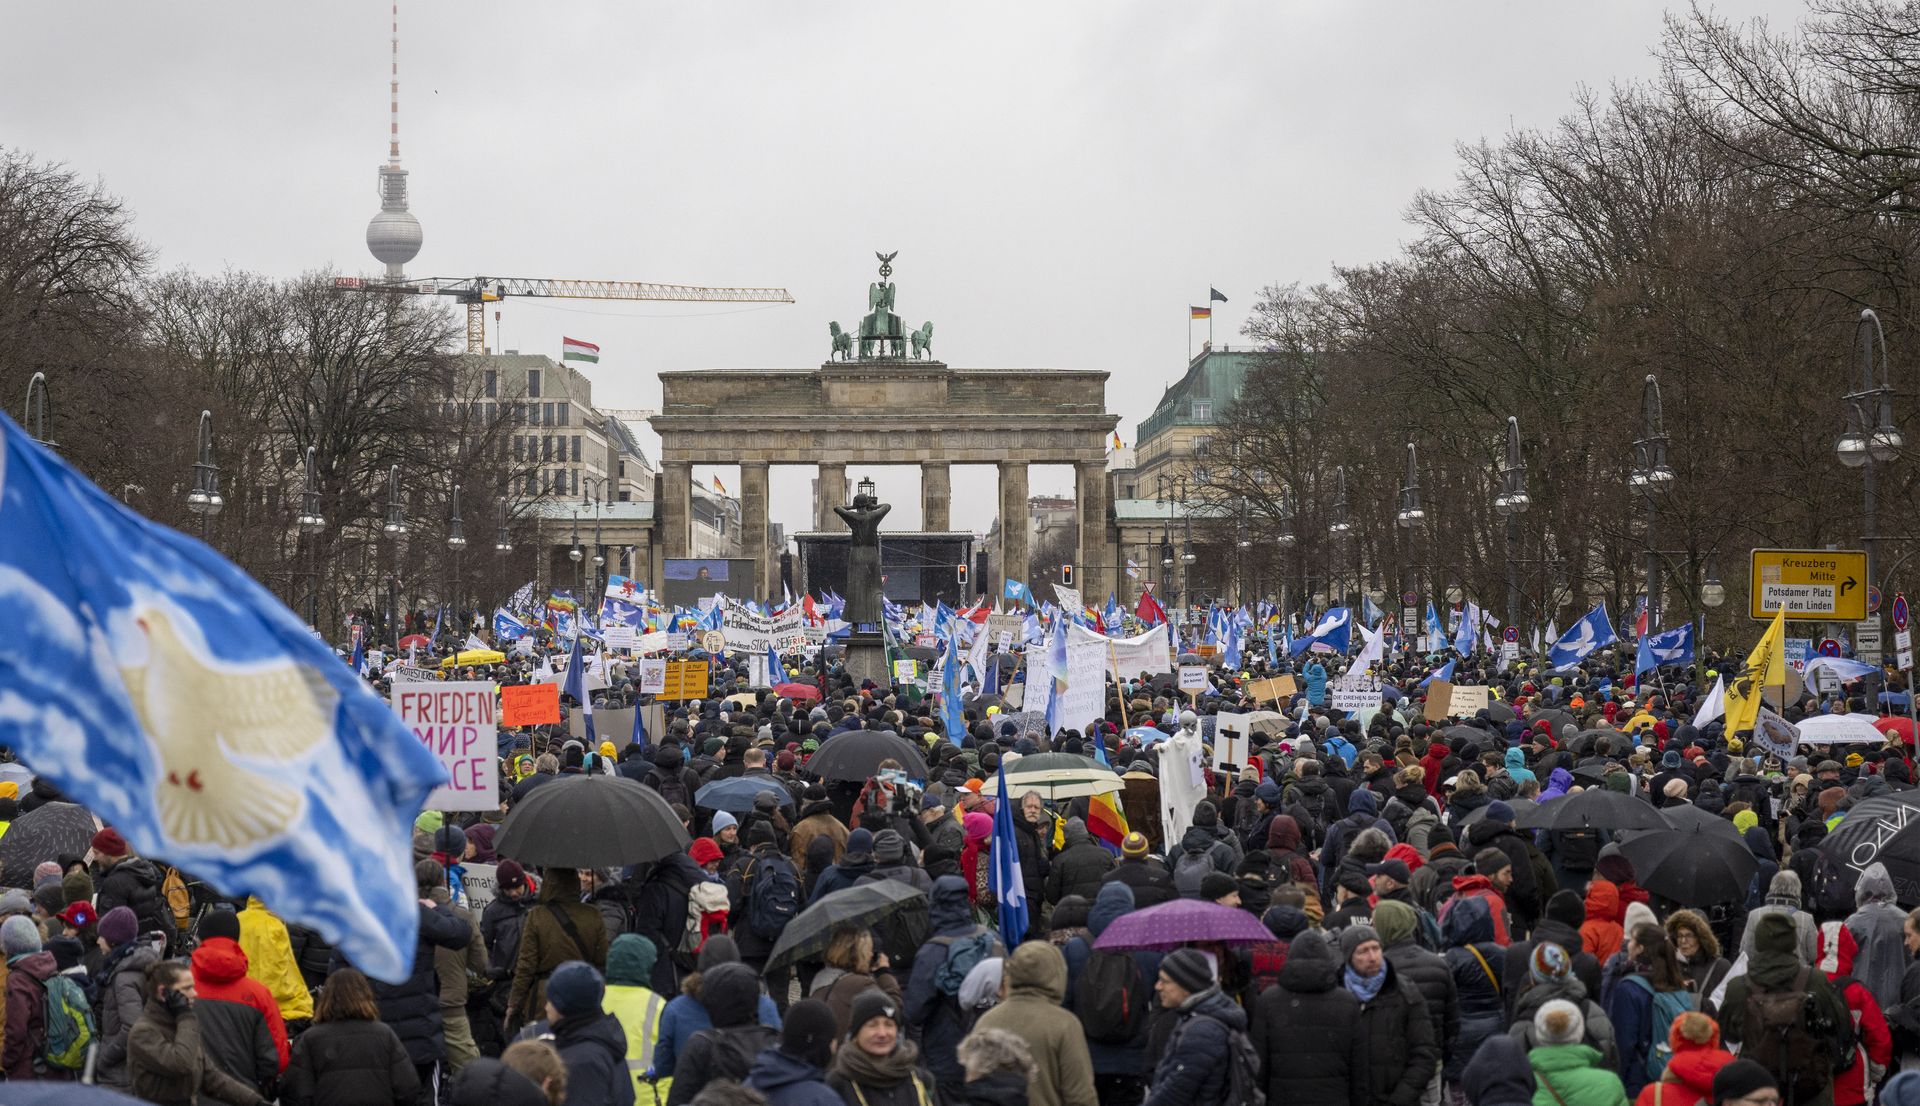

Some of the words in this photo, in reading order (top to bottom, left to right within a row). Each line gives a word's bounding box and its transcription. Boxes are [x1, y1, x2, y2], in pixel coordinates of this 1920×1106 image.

[1782, 558, 1836, 570] Kreuzberg
[1810, 571, 1836, 581] Mitte
[1768, 587, 1809, 597] Potsdamer
[1812, 587, 1832, 597] Platz
[1764, 600, 1784, 609] Unte
[1789, 600, 1803, 610] den
[1806, 600, 1832, 610] Linden
[401, 691, 493, 725] FRIEDEN
